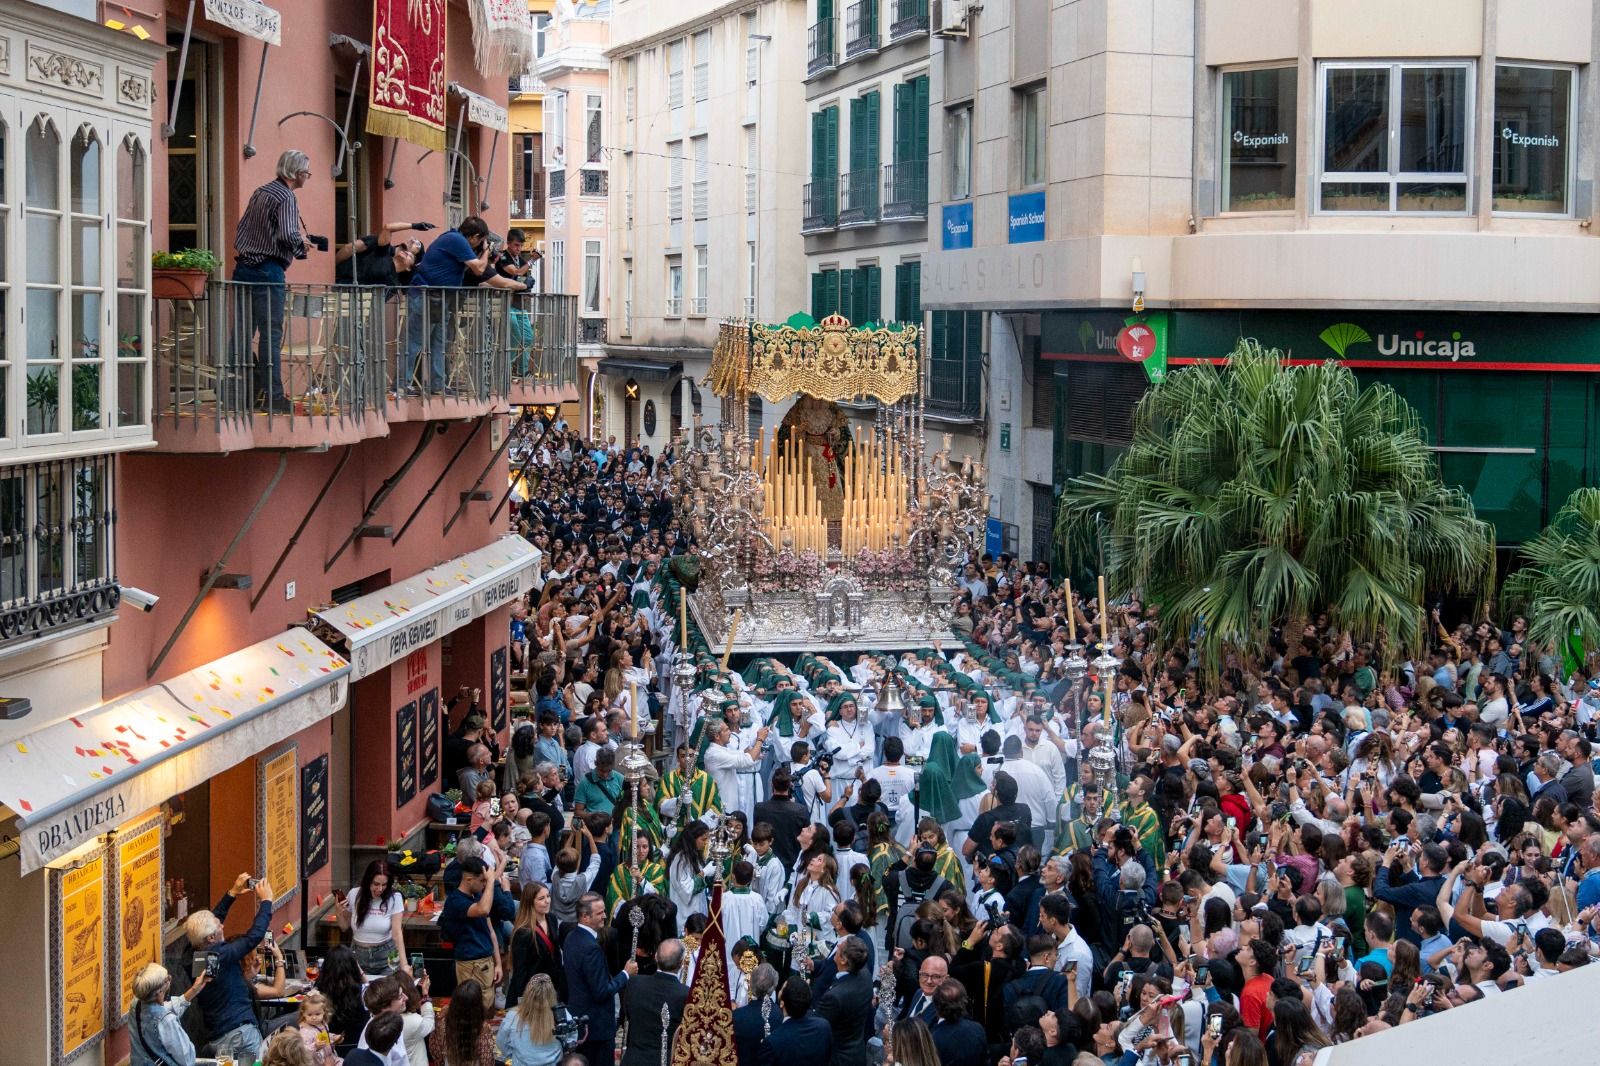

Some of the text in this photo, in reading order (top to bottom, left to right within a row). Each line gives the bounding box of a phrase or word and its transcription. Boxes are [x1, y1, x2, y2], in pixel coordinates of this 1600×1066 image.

[1243, 132, 1289, 148] Expanish
[1512, 133, 1559, 148] Expanish
[951, 222, 969, 235] Expanish
[1010, 211, 1045, 229] Spanish School
[1377, 331, 1476, 362] Unicaja
[389, 630, 408, 658] PEPA
